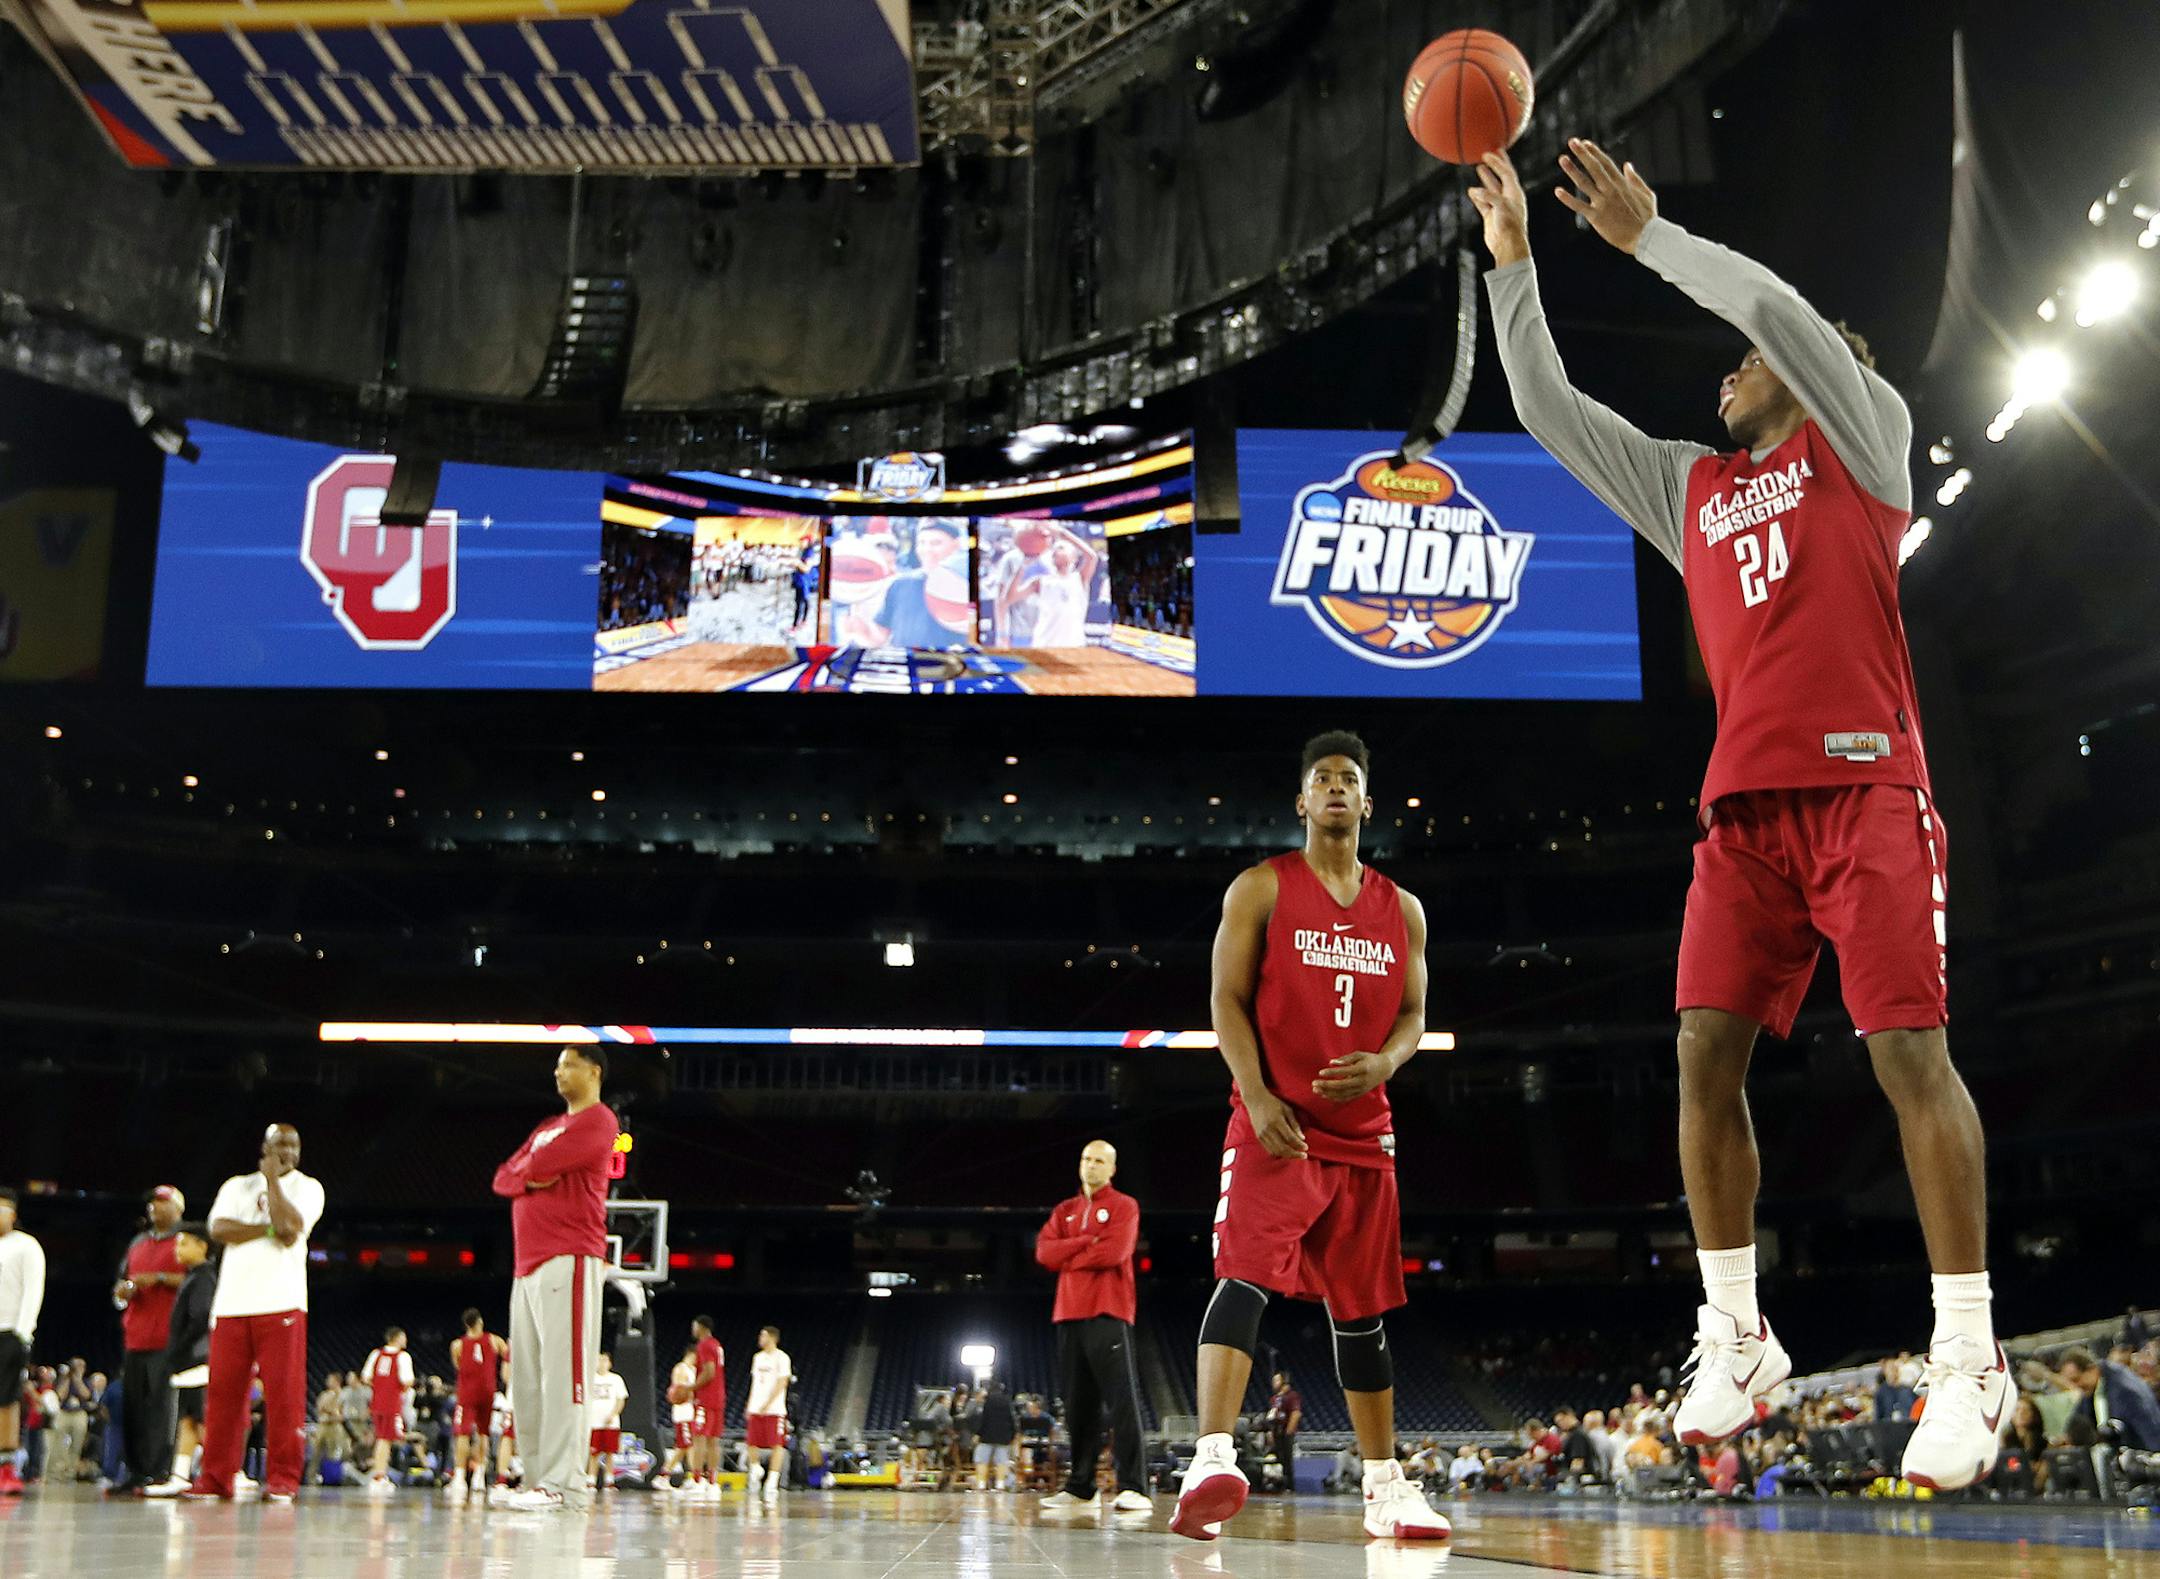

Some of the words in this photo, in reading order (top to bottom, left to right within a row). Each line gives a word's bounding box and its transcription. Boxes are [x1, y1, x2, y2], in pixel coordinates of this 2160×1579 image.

[1343, 497, 1415, 529] FINAL
[1419, 504, 1484, 534] FOUR
[1285, 520, 1527, 600] FRIDAY
[1733, 521, 1790, 609] 24
[1295, 929, 1396, 964] OKLAHOMA
[1315, 952, 1389, 976] BASKETBALL
[1334, 974, 1355, 1028] 3
